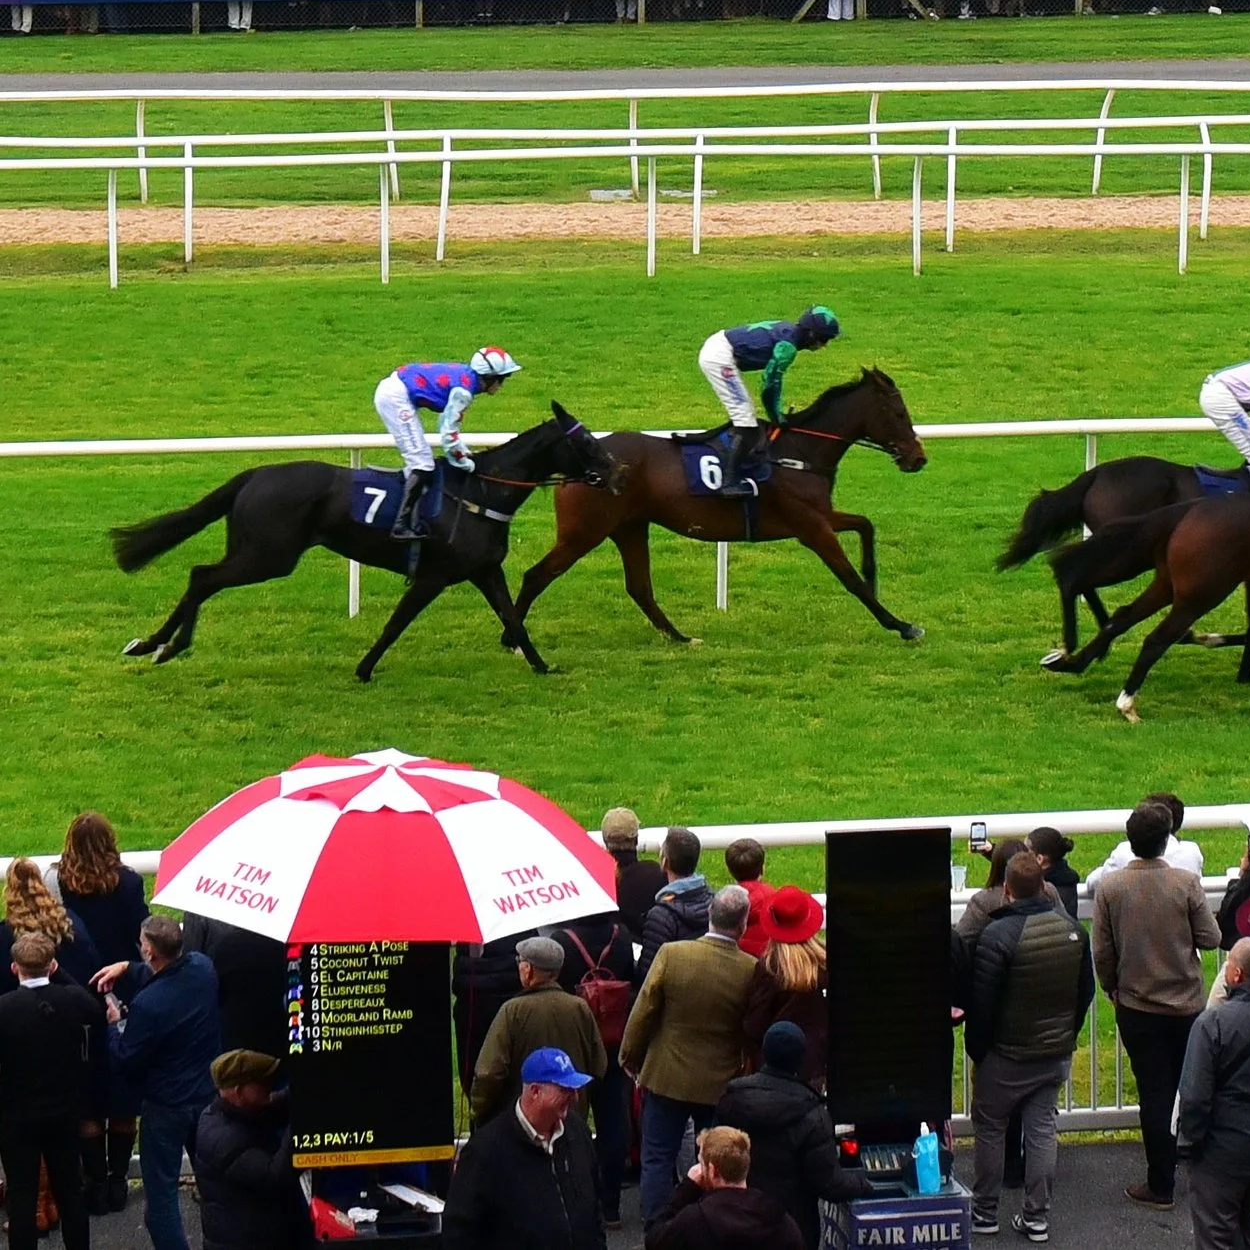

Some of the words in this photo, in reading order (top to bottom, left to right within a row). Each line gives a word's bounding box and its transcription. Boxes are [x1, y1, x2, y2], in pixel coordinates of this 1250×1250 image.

[700, 455, 723, 490] 6
[364, 486, 387, 524] 7
[233, 862, 272, 886] TIM
[501, 864, 544, 887] TIM
[195, 875, 280, 914] WATSON
[492, 880, 580, 915] WATSON
[310, 943, 318, 956] 4
[319, 943, 365, 956] STRIKING
[369, 941, 378, 952] A
[381, 940, 409, 953] POSE
[310, 957, 318, 970] 5
[319, 957, 368, 969] COCONUT
[372, 954, 404, 966] TWIST
[310, 971, 319, 984] 6
[320, 971, 333, 983] EL
[336, 969, 389, 982] CAPITAINE
[311, 985, 319, 998] 7
[320, 984, 386, 997] ELUSIVENESS
[311, 998, 319, 1011] 8
[320, 997, 385, 1010] DESPEREAUX
[311, 1012, 320, 1025] 9
[321, 1011, 379, 1024] MOORLAND
[305, 1026, 320, 1039] 10
[321, 1023, 403, 1038] STINGINHISSTEP
[313, 1039, 320, 1052] 3
[292, 1133, 321, 1148] 1,2,3
[296, 1155, 327, 1165] CASH
[330, 1153, 358, 1164] ONLY
[857, 1226, 906, 1246] FAIR
[912, 1222, 962, 1244] MILE
